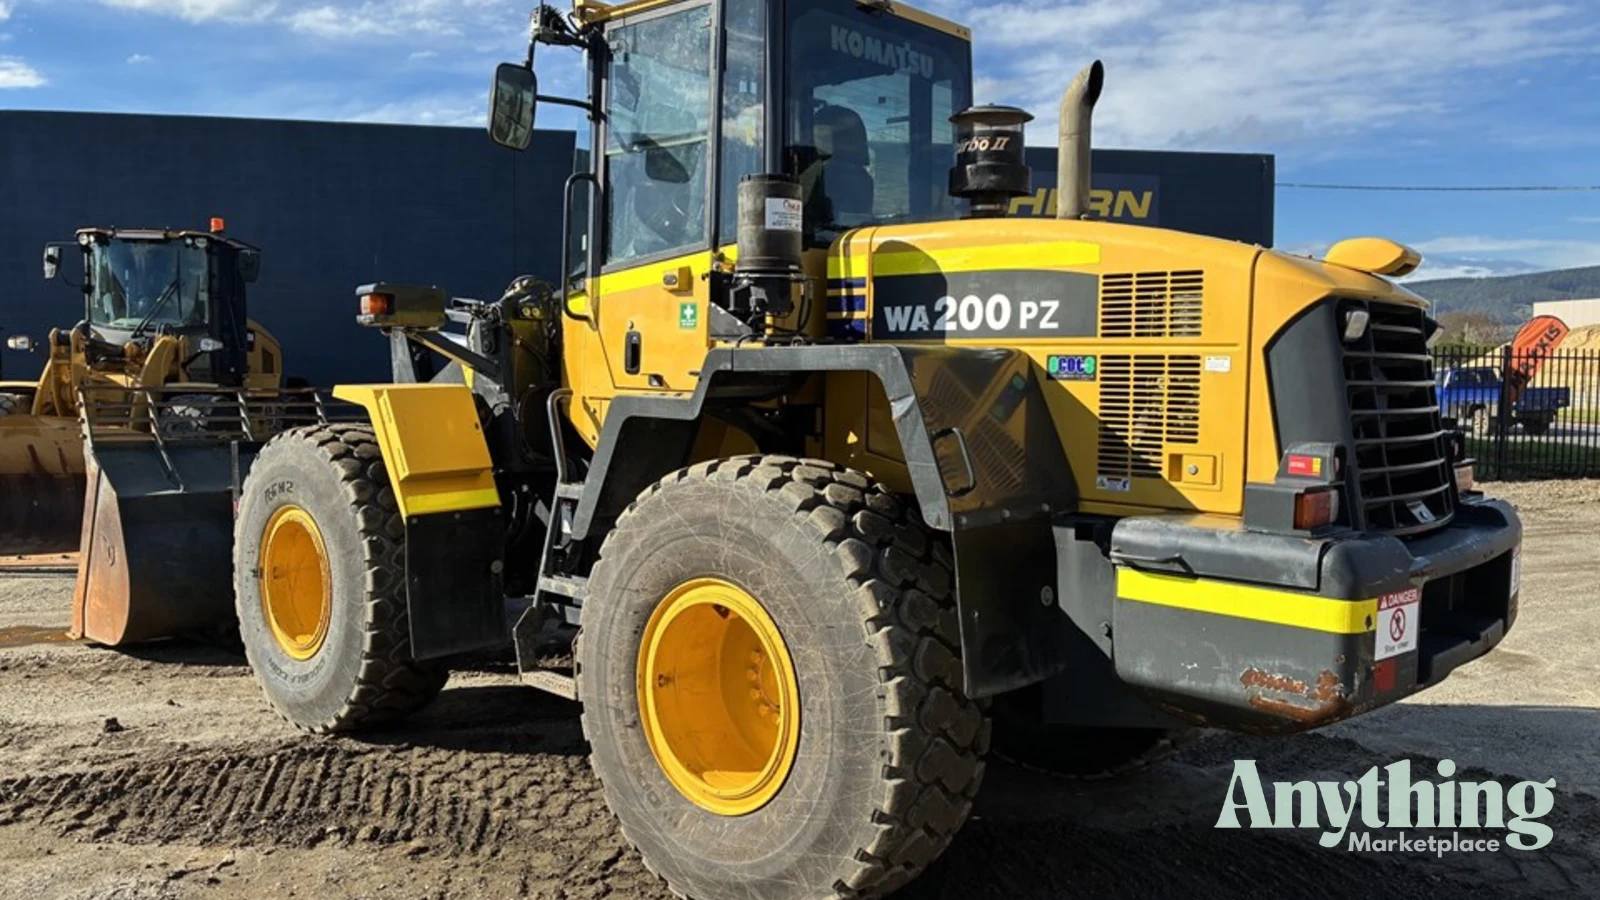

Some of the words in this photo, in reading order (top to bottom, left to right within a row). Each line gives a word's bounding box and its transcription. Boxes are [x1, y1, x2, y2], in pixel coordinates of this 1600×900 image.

[831, 25, 934, 79] KOMATSU
[883, 305, 930, 332] WA
[933, 294, 1012, 331] 200
[1019, 300, 1060, 330] PZ
[1388, 589, 1418, 606] DANGER
